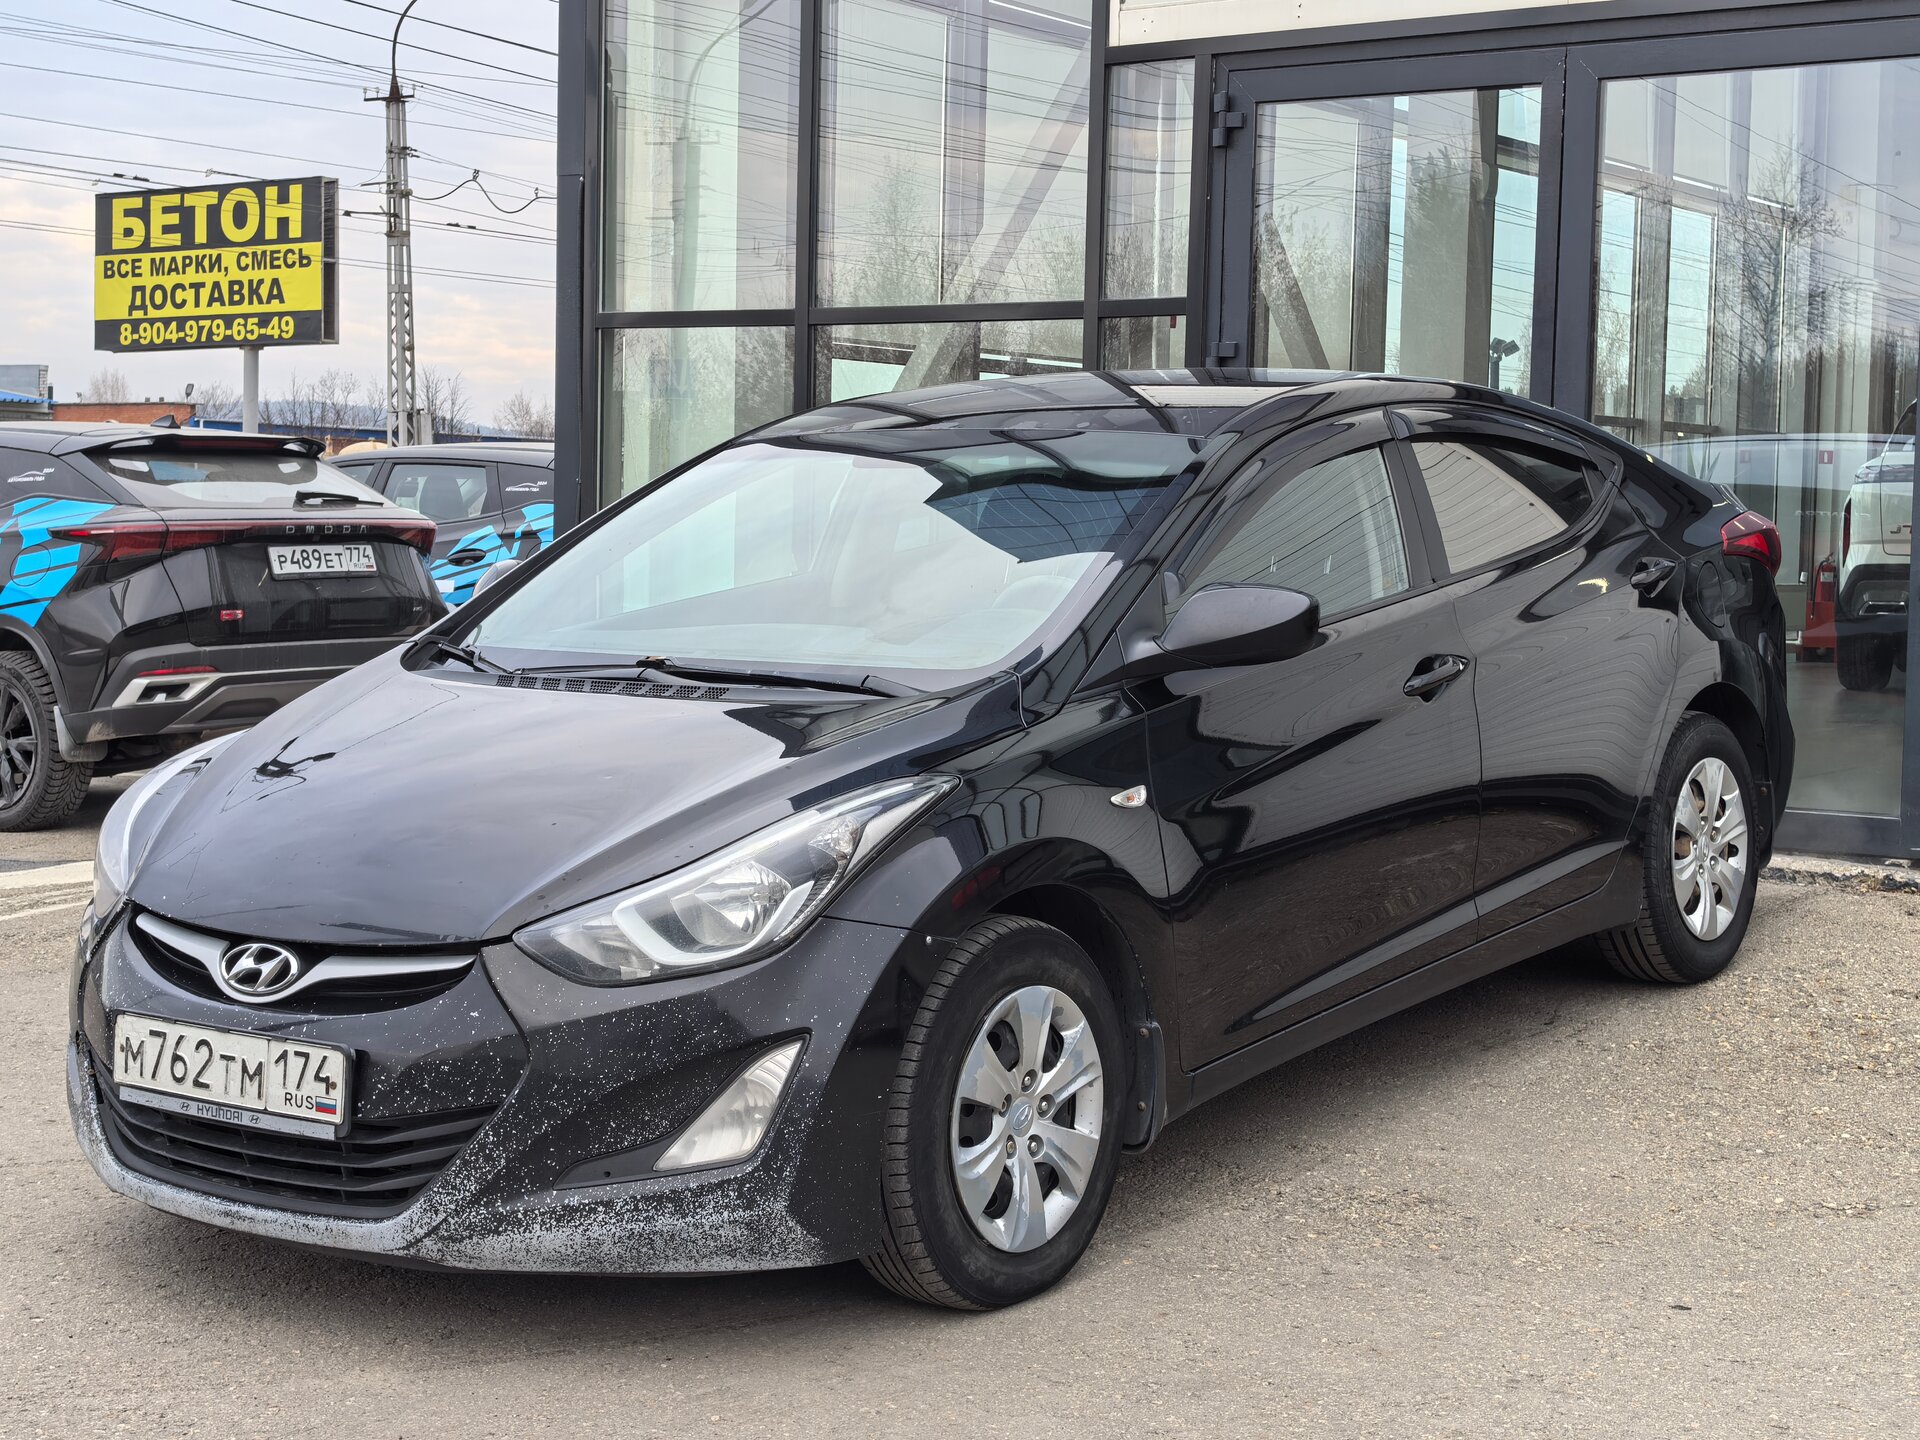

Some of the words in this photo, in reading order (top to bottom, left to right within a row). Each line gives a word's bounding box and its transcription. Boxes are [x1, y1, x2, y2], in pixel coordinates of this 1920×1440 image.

[112, 184, 303, 250] БЕТОН
[103, 258, 143, 279] ВСЕ
[150, 253, 229, 277] МАРКИ,
[236, 248, 312, 272] СМЕСЬ
[128, 277, 286, 317] ДОСТАВКА
[119, 316, 295, 346] 8-904-979-65-49
[277, 548, 343, 571] Р489ЕТ
[345, 547, 371, 562] 774
[124, 1029, 265, 1101] М762ТМ
[274, 1049, 330, 1095] 174
[196, 1103, 243, 1122] HYUNDAI
[284, 1092, 315, 1110] RUS
